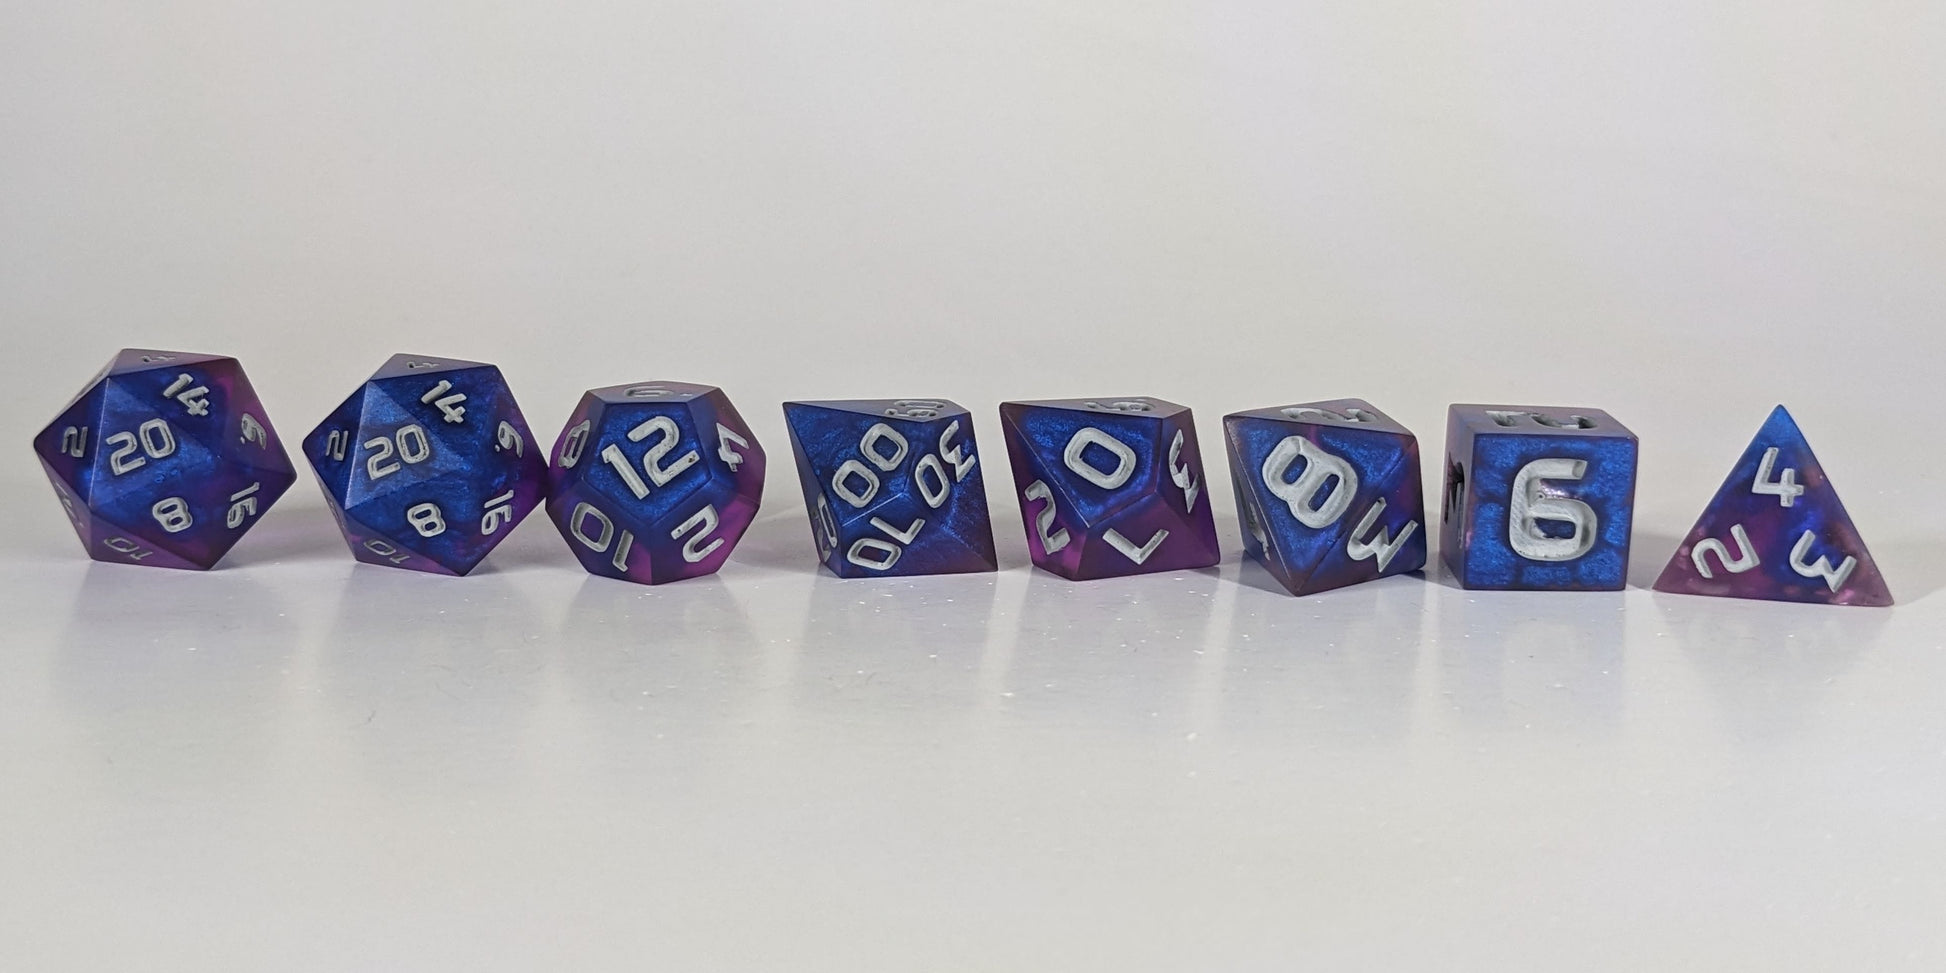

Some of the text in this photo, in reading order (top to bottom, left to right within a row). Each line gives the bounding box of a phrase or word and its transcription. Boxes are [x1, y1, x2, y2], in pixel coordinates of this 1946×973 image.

[163, 373, 209, 416] 14
[421, 380, 467, 423] 14
[105, 418, 176, 476] 20
[364, 424, 430, 481] 20
[601, 416, 700, 500] 12
[716, 422, 749, 472] 4
[832, 423, 908, 508] 00
[915, 420, 976, 508] 30
[1064, 427, 1136, 489] 0
[1169, 429, 1200, 514] 3
[1752, 447, 1804, 507] 4
[1262, 435, 1358, 529] 8
[1509, 458, 1597, 561] 6
[152, 497, 193, 532] 8
[407, 503, 446, 538] 8
[570, 502, 634, 572] 10
[671, 504, 725, 562] 2
[847, 517, 925, 570] 70
[1025, 479, 1071, 555] 2
[1347, 497, 1418, 573] 3
[1102, 528, 1169, 565] 7
[1691, 524, 1760, 578] 2
[1790, 530, 1857, 593] 3
